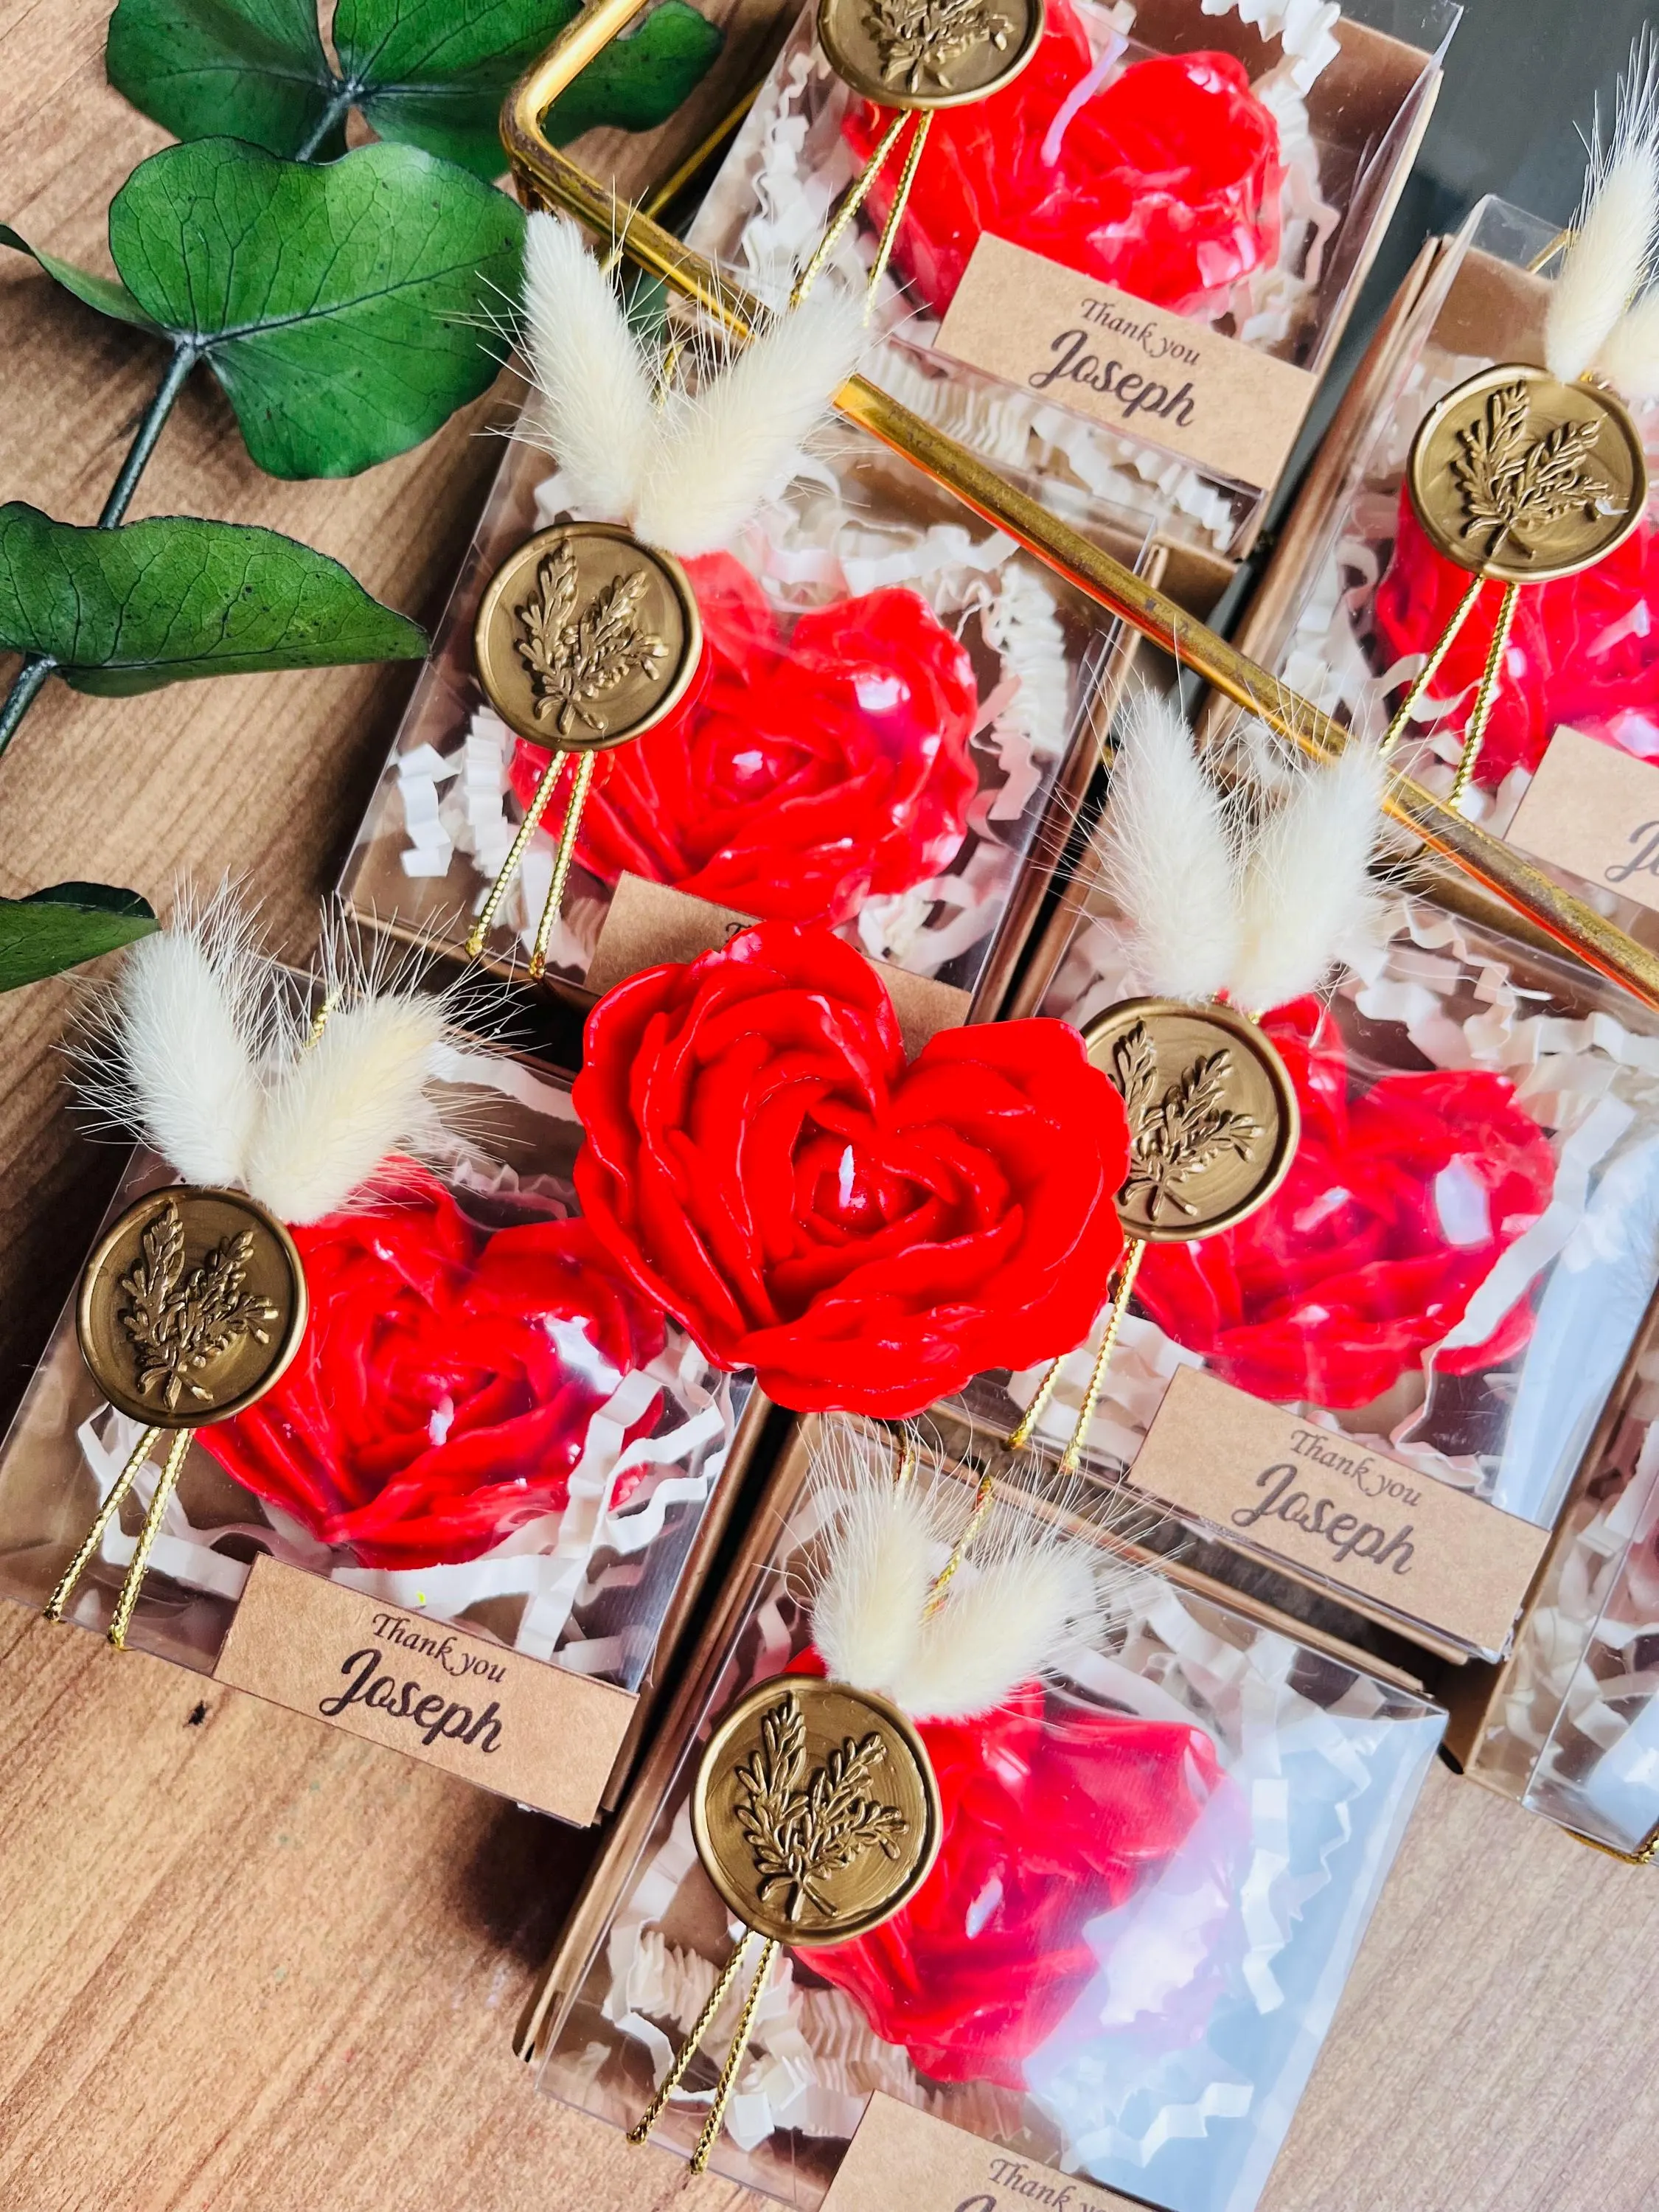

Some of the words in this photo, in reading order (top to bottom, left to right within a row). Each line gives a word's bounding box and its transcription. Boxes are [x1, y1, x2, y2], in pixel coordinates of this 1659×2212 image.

[1081, 298, 1157, 354] Thank
[1149, 337, 1200, 366] you
[1029, 329, 1196, 427] Joseph
[1290, 1429, 1376, 1492] Thank
[1365, 1475, 1422, 1506] you
[1231, 1462, 1416, 1575] Joseph
[372, 1613, 458, 1672] Thank
[449, 1652, 507, 1683] you
[319, 1647, 502, 1753] Joseph
[988, 2157, 1077, 2212] Thank
